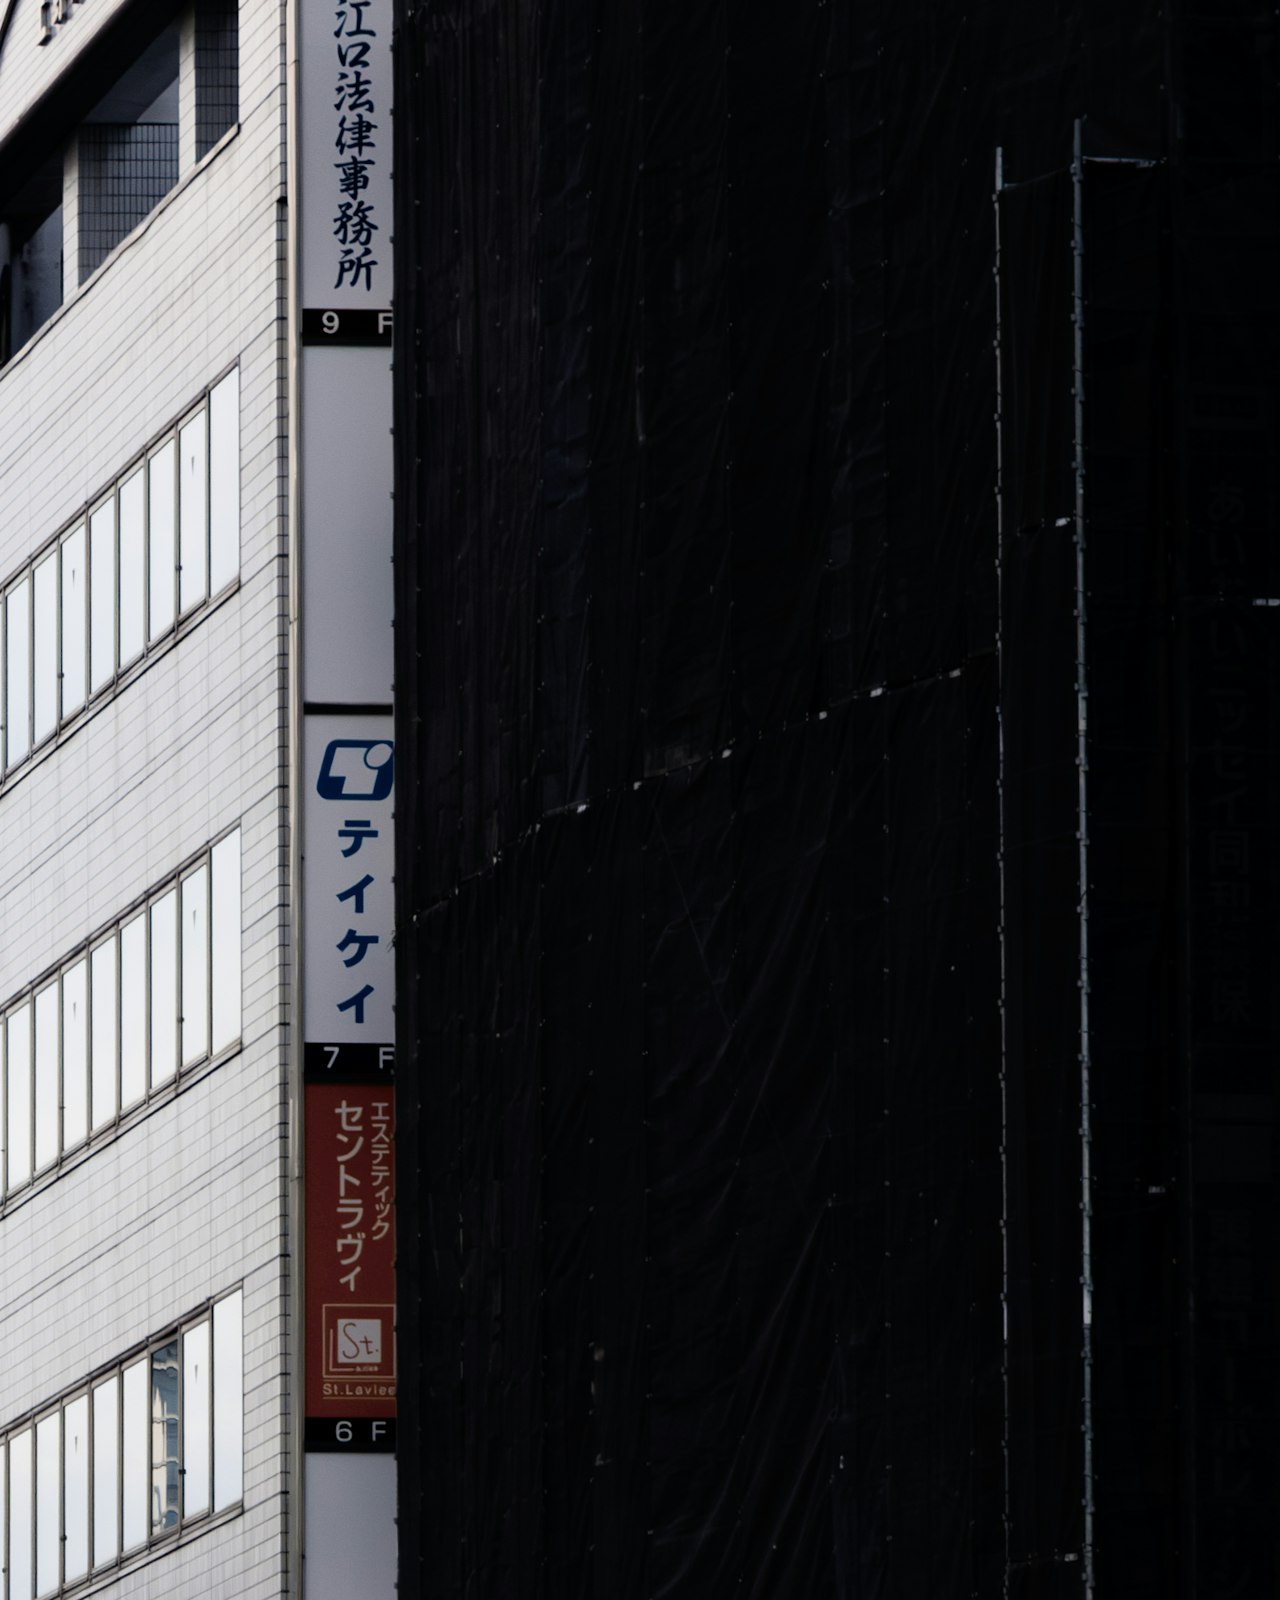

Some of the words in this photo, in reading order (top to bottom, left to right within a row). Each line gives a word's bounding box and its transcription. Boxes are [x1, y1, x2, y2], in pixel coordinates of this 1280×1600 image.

[322, 311, 340, 334] 9
[336, 820, 379, 1024] テイケイ
[323, 1047, 340, 1069] 7
[378, 1047, 395, 1069] F
[334, 1100, 366, 1292] セントラヴィ
[371, 1102, 390, 1241] エステティック
[335, 1420, 352, 1442] 6
[372, 1421, 387, 1442] F
